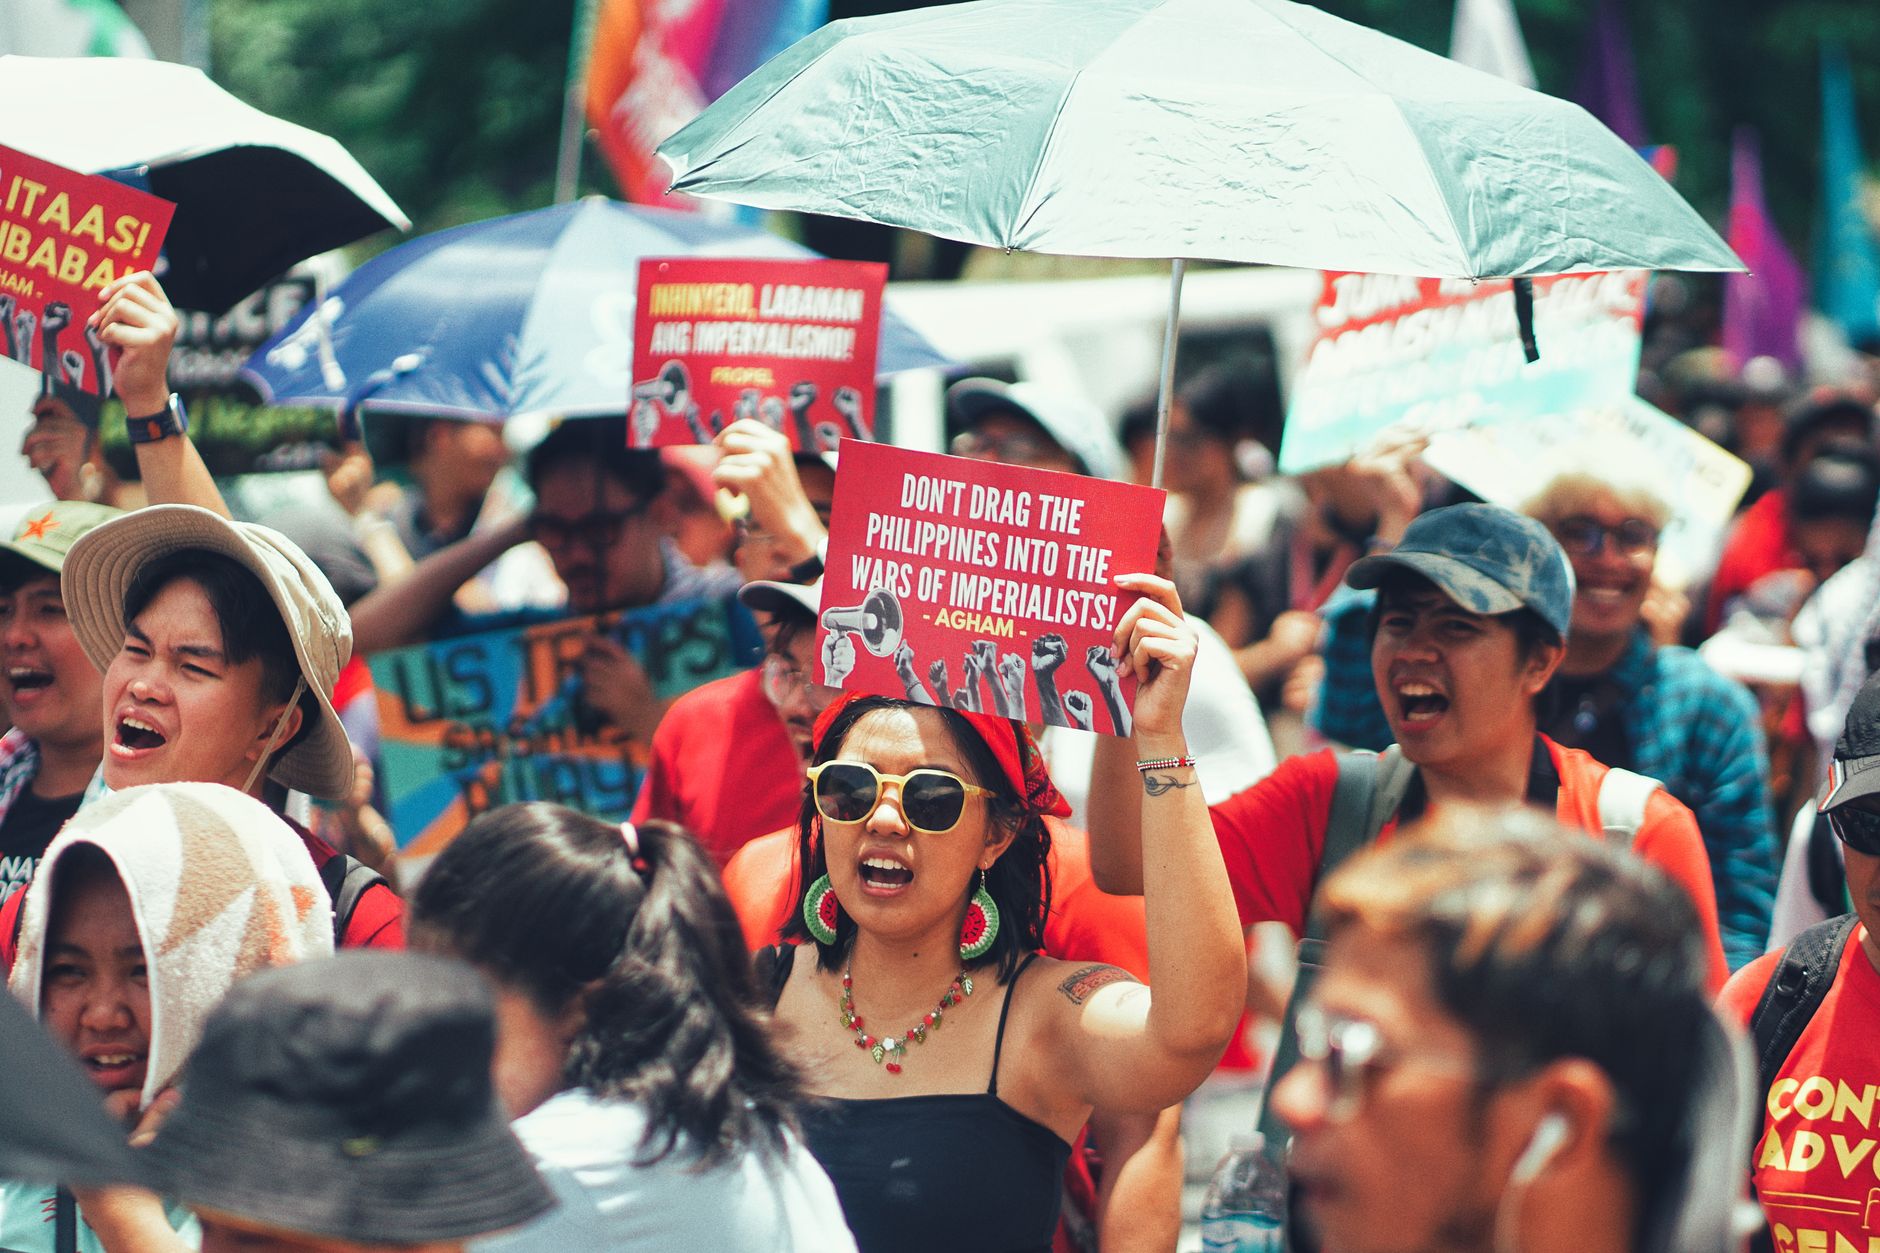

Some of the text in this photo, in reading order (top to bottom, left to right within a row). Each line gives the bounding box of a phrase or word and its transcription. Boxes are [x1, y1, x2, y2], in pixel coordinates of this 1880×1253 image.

[5, 175, 152, 258] ITAAS!
[0, 219, 136, 292] IBABA
[759, 283, 865, 322] LABANAN
[649, 320, 693, 356] ANG
[901, 473, 1085, 536] DON'T DRAG THE
[865, 512, 1113, 585] PHILIPPINES INTO THE
[851, 554, 1118, 631] WARS OF IMPERIALISTS!
[934, 607, 1014, 639] AGHAM
[395, 643, 492, 723] US
[1767, 1075, 1880, 1131] CON
[1758, 1124, 1880, 1180] ADV
